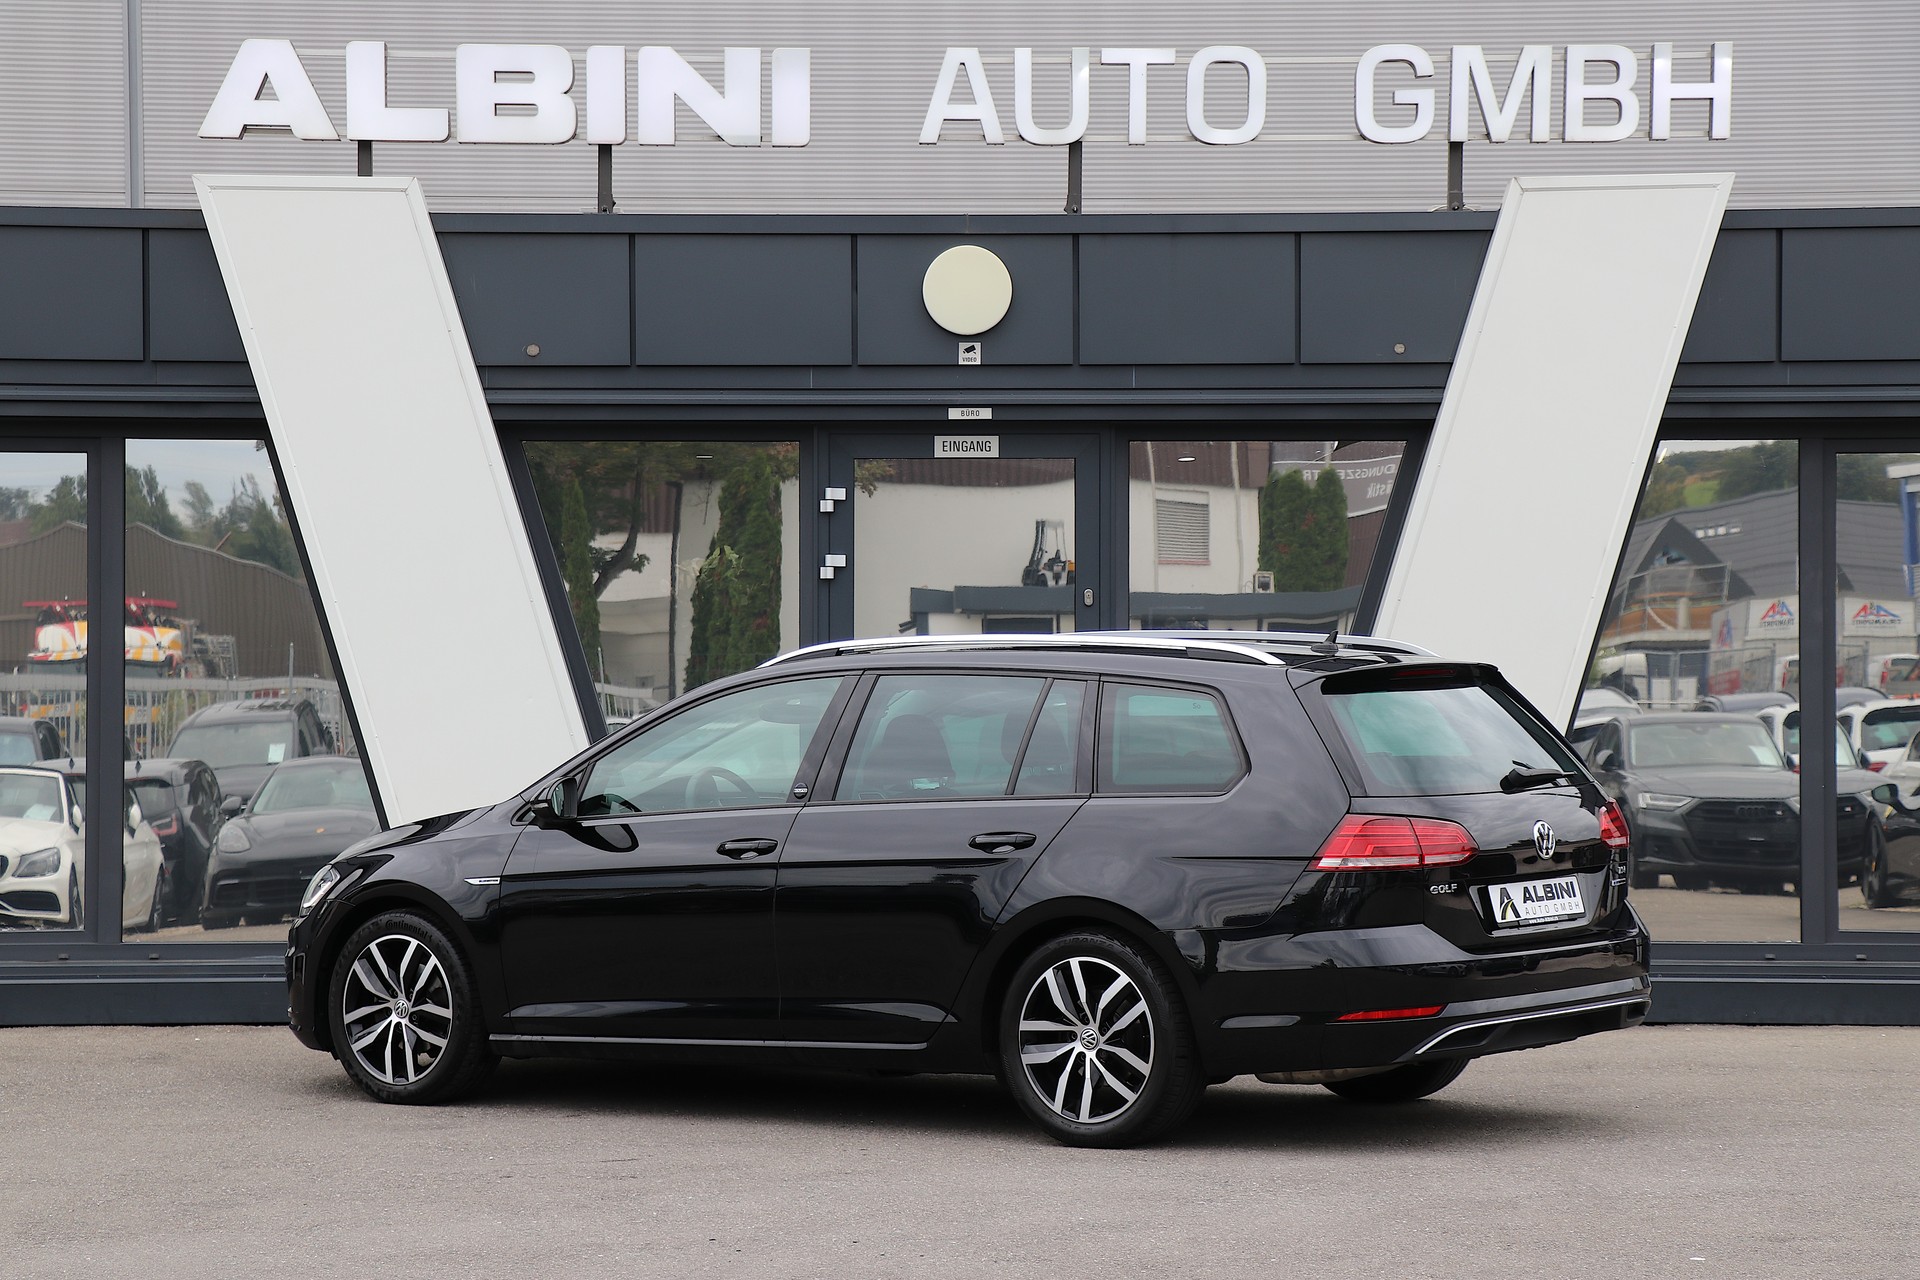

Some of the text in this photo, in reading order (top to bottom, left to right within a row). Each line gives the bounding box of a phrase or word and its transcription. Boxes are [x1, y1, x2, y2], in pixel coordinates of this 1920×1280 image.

[197, 38, 1734, 147] ALBINI AUTO GMBH
[960, 409, 980, 417] BÜRO
[942, 440, 992, 453] EINGANG
[1430, 883, 1458, 894] GOLF
[1523, 881, 1577, 904] ALBINI
[1525, 901, 1581, 916] AUTO GMBH
[385, 920, 429, 938] Continental
